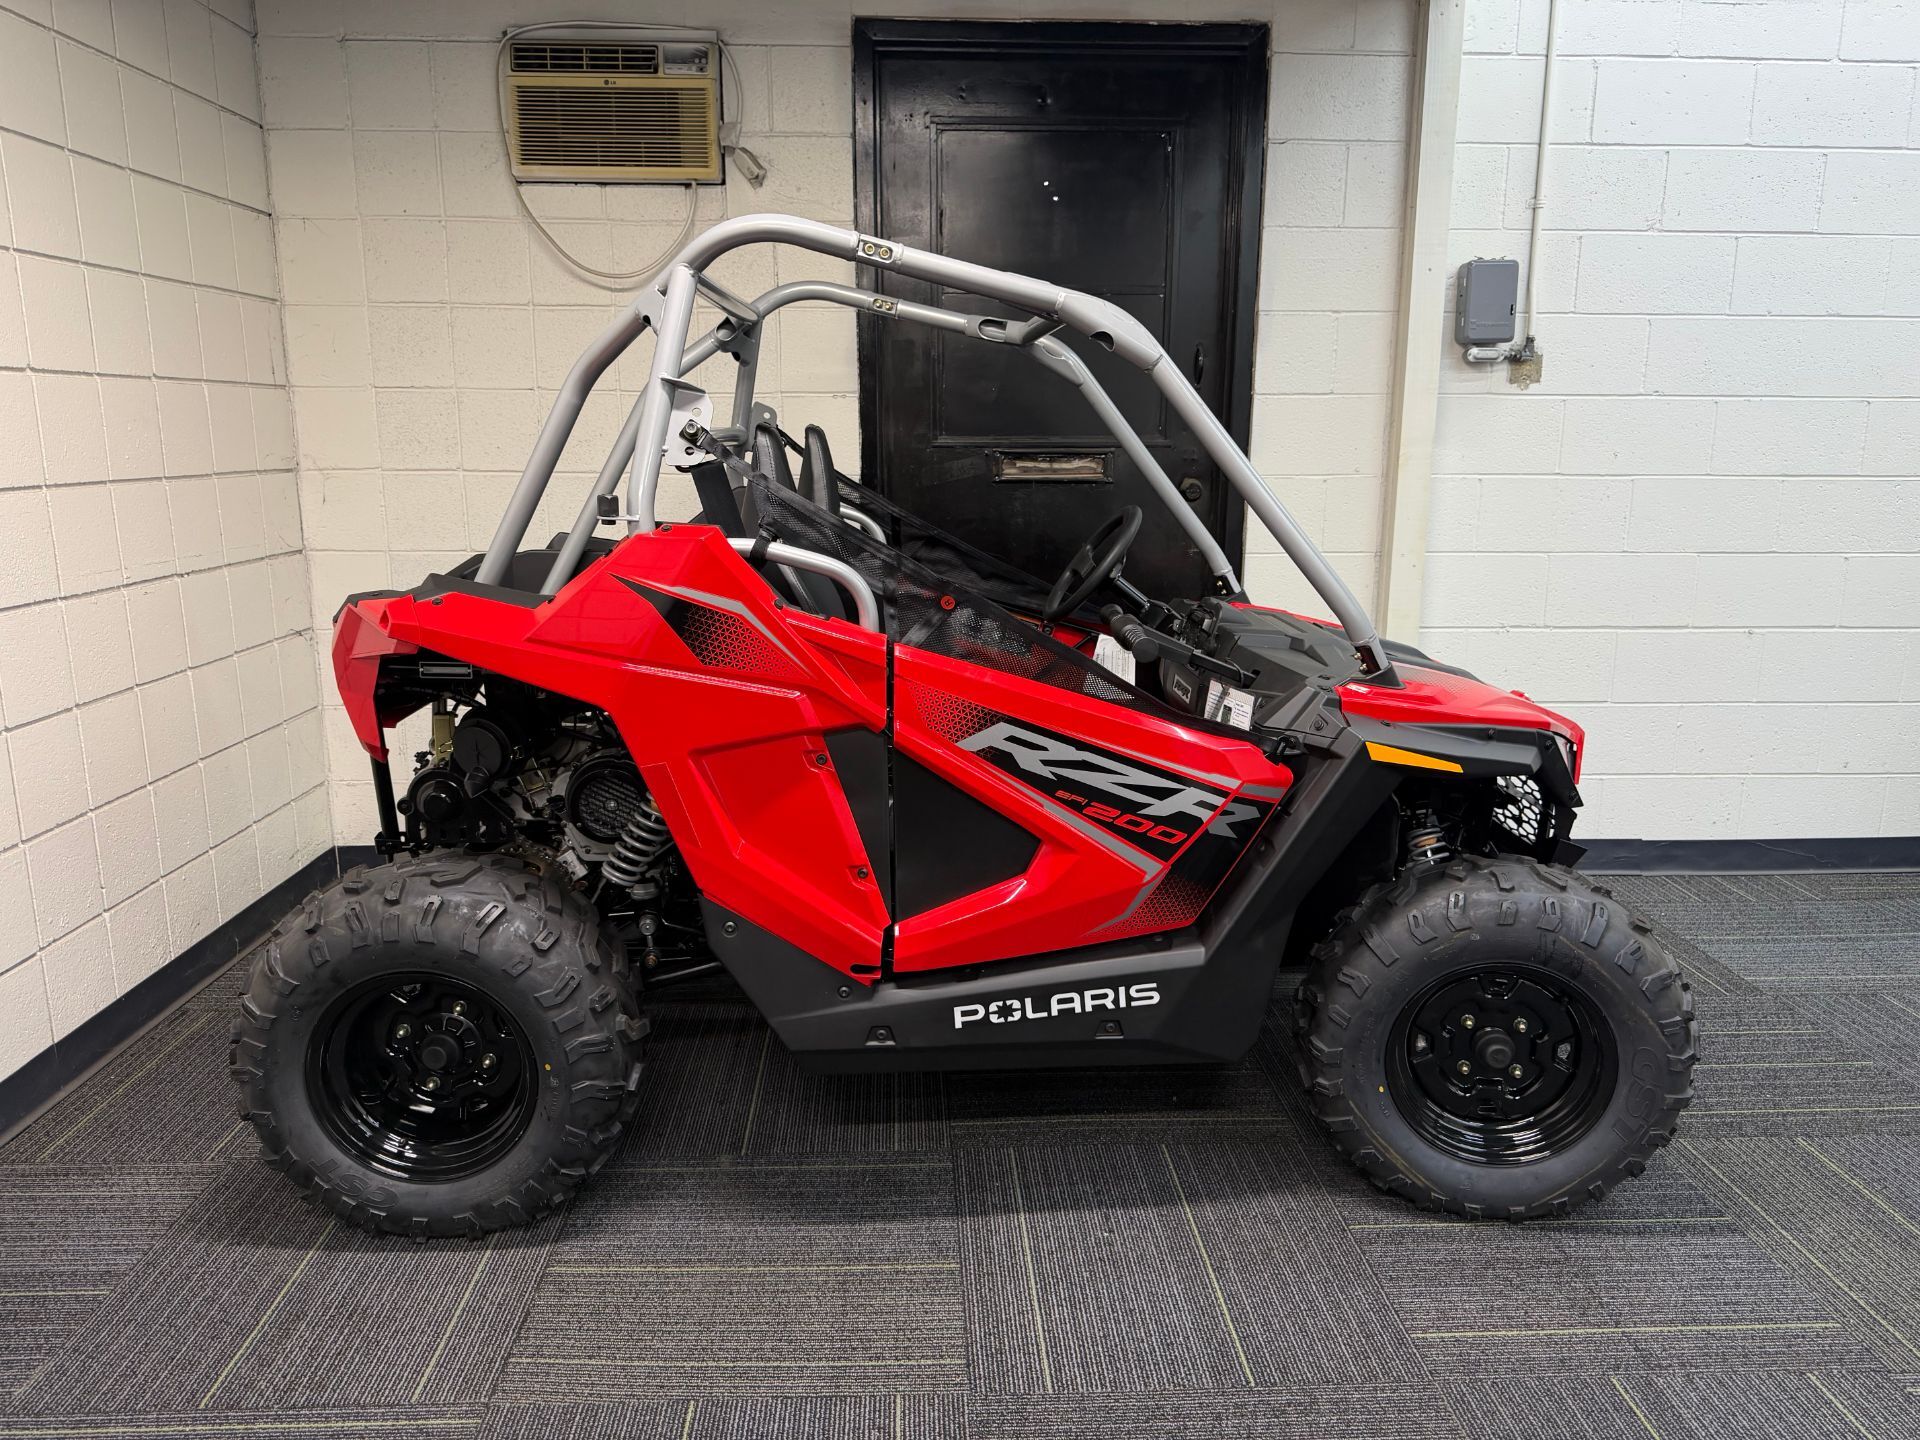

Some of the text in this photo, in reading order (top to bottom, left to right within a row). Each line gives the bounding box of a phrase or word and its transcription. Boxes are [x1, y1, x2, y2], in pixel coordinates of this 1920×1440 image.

[956, 722, 1261, 838] RZR
[1055, 790, 1187, 845] EFI 200
[954, 982, 1160, 1029] POLARIS
